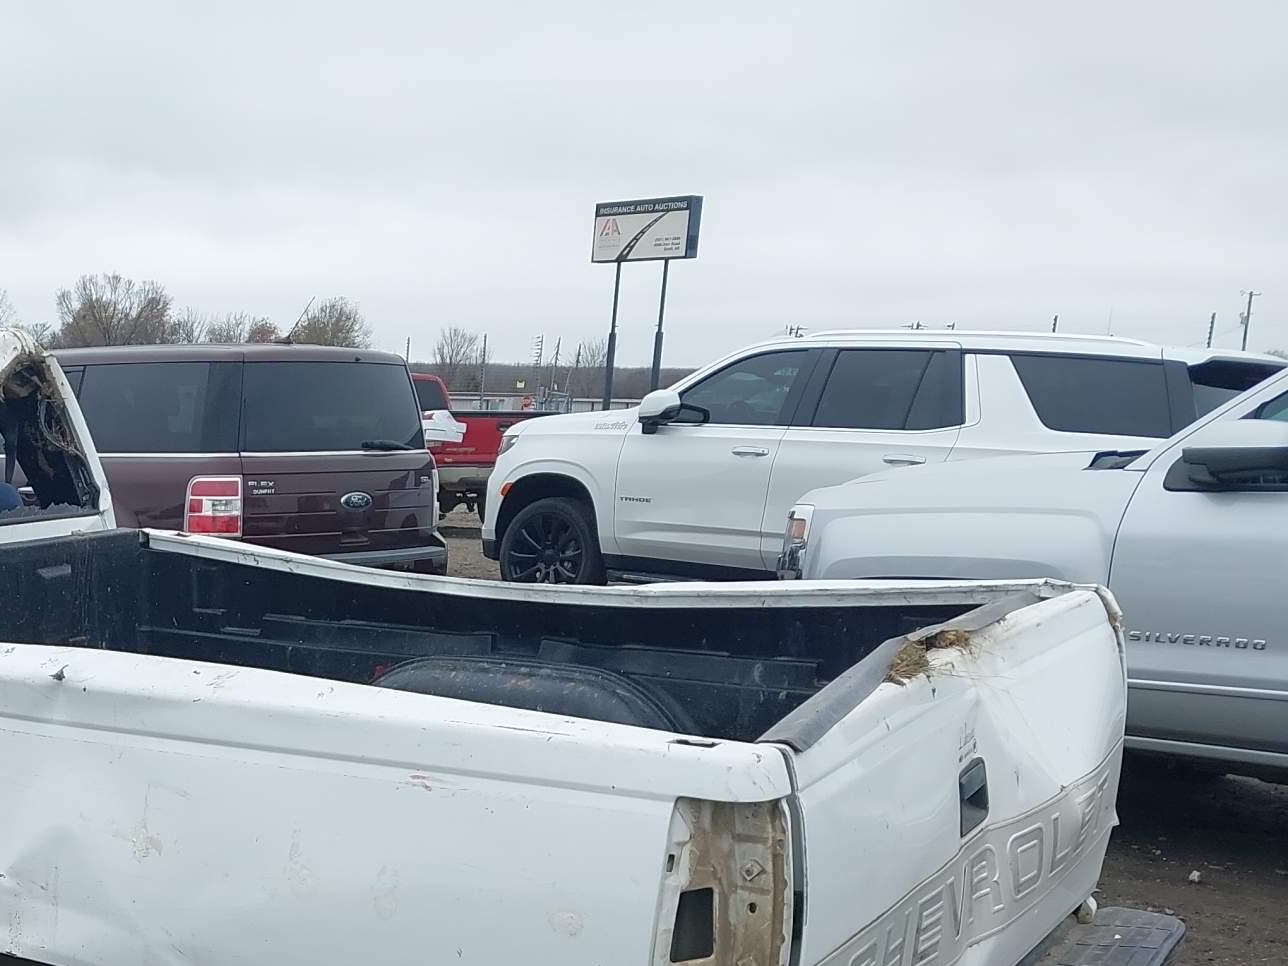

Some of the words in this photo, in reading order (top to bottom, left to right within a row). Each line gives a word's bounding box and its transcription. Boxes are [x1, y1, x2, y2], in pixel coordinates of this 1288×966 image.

[599, 205, 635, 215] INSURANCE
[636, 203, 653, 212] AUTO
[655, 200, 688, 210] AUCTIONS
[1128, 630, 1267, 651] SILVERADO
